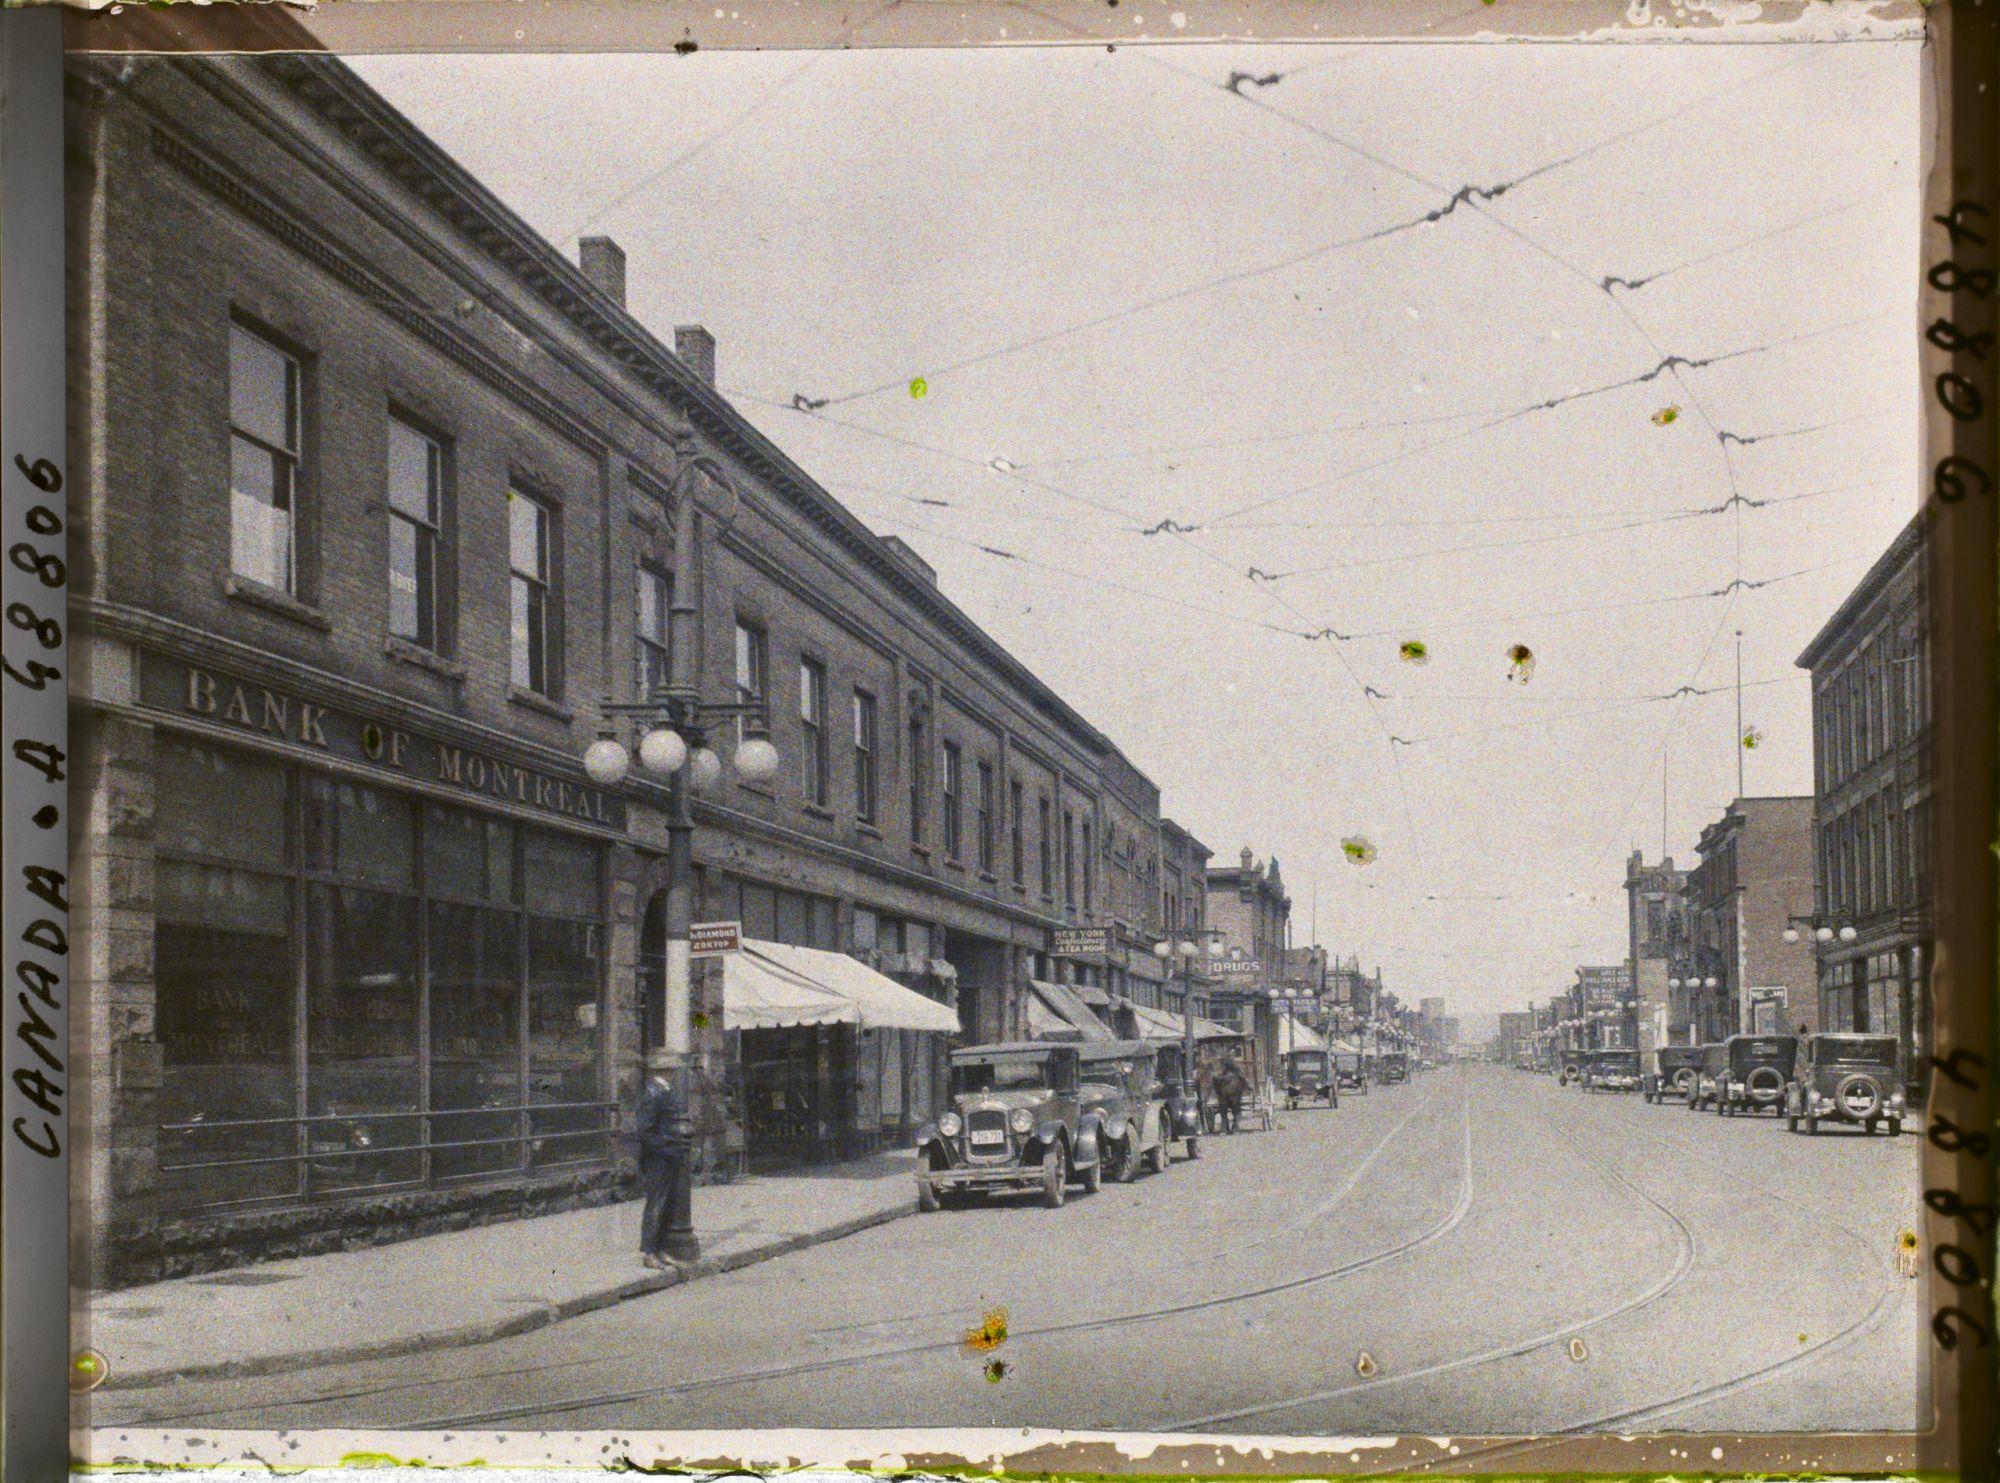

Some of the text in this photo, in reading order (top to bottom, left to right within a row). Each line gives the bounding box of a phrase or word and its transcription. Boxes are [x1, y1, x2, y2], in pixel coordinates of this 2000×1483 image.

[1926, 200, 1997, 505] 48806
[12, 739, 66, 783] A
[187, 668, 610, 825] BANK OF MONTREAL
[697, 929, 736, 939] DIAMOND
[1054, 929, 1106, 938] NEW YORK
[1213, 960, 1261, 972] DRUGS
[13, 865, 68, 1158] CANADA
[1923, 1047, 1997, 1351] 48806
